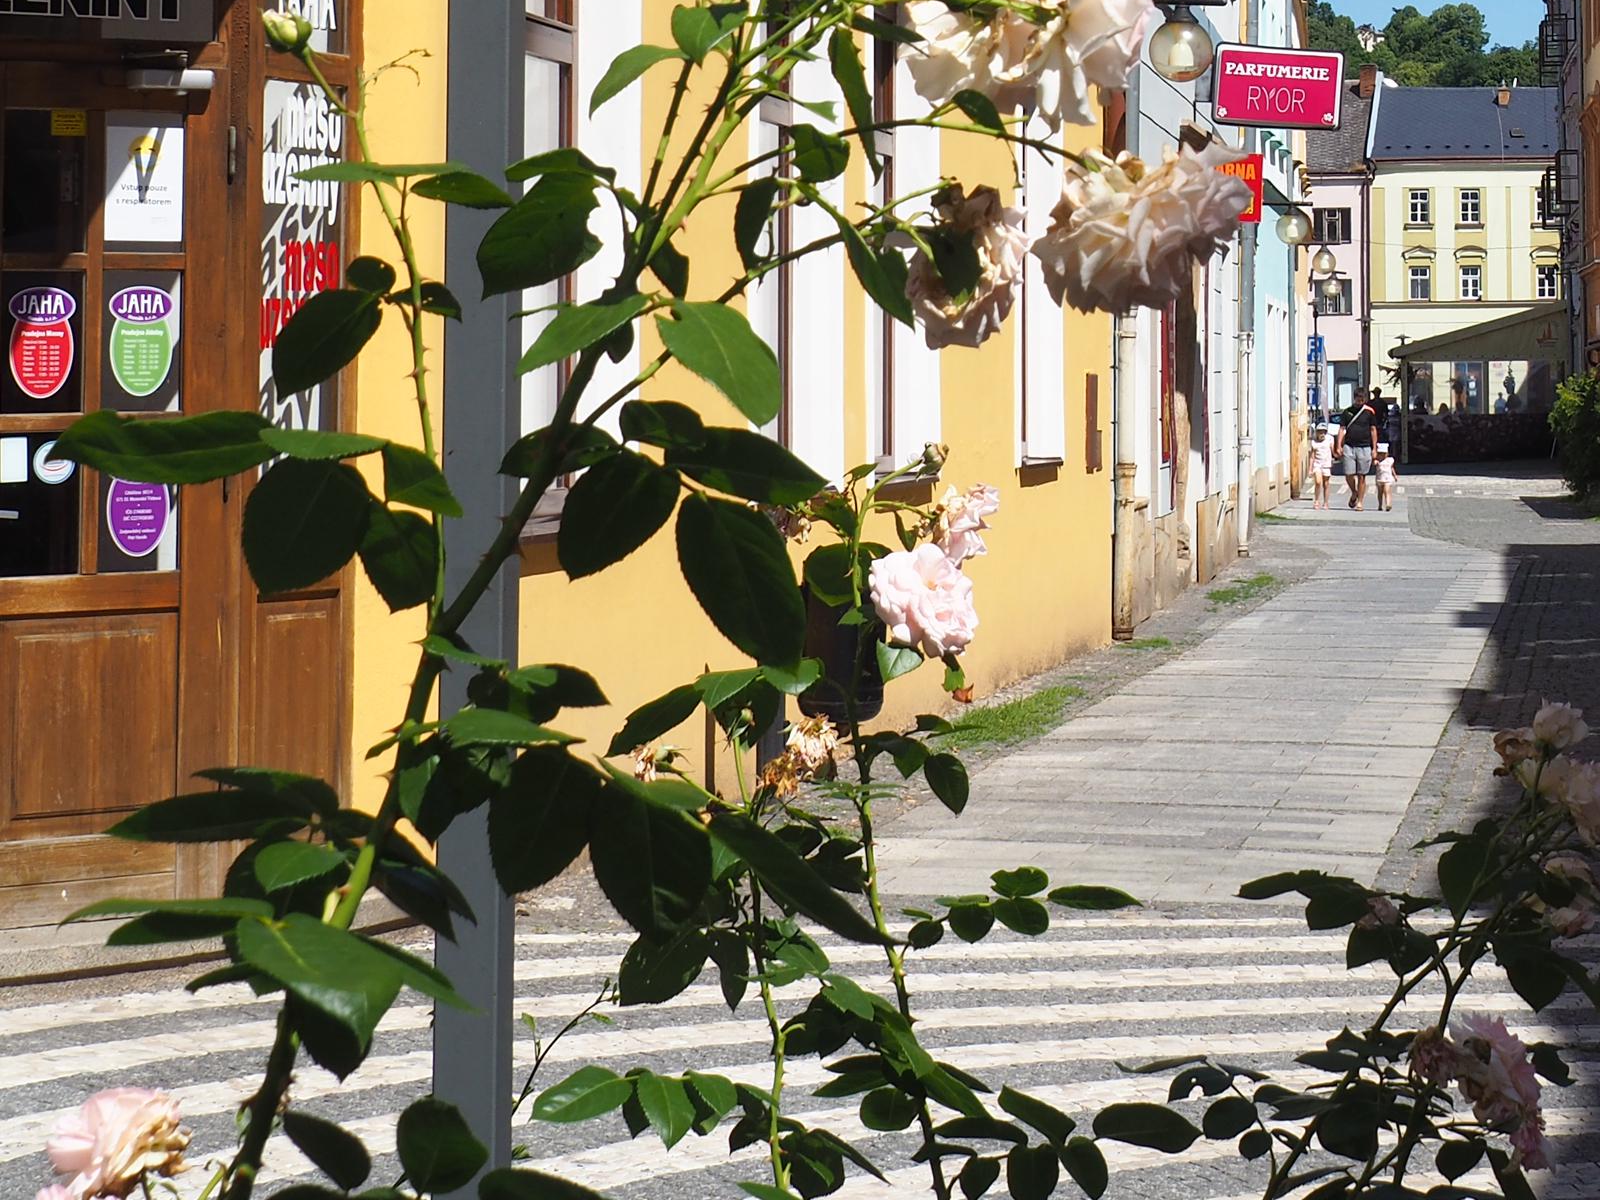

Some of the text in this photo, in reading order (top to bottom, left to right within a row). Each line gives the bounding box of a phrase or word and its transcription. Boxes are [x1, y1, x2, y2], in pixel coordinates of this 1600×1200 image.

[1225, 62, 1330, 82] PARFUMERIE
[1247, 86, 1306, 114] RYOR
[287, 94, 341, 152] maso
[285, 239, 339, 292] maso
[18, 294, 65, 314] JAHA
[118, 294, 165, 314] JAHA
